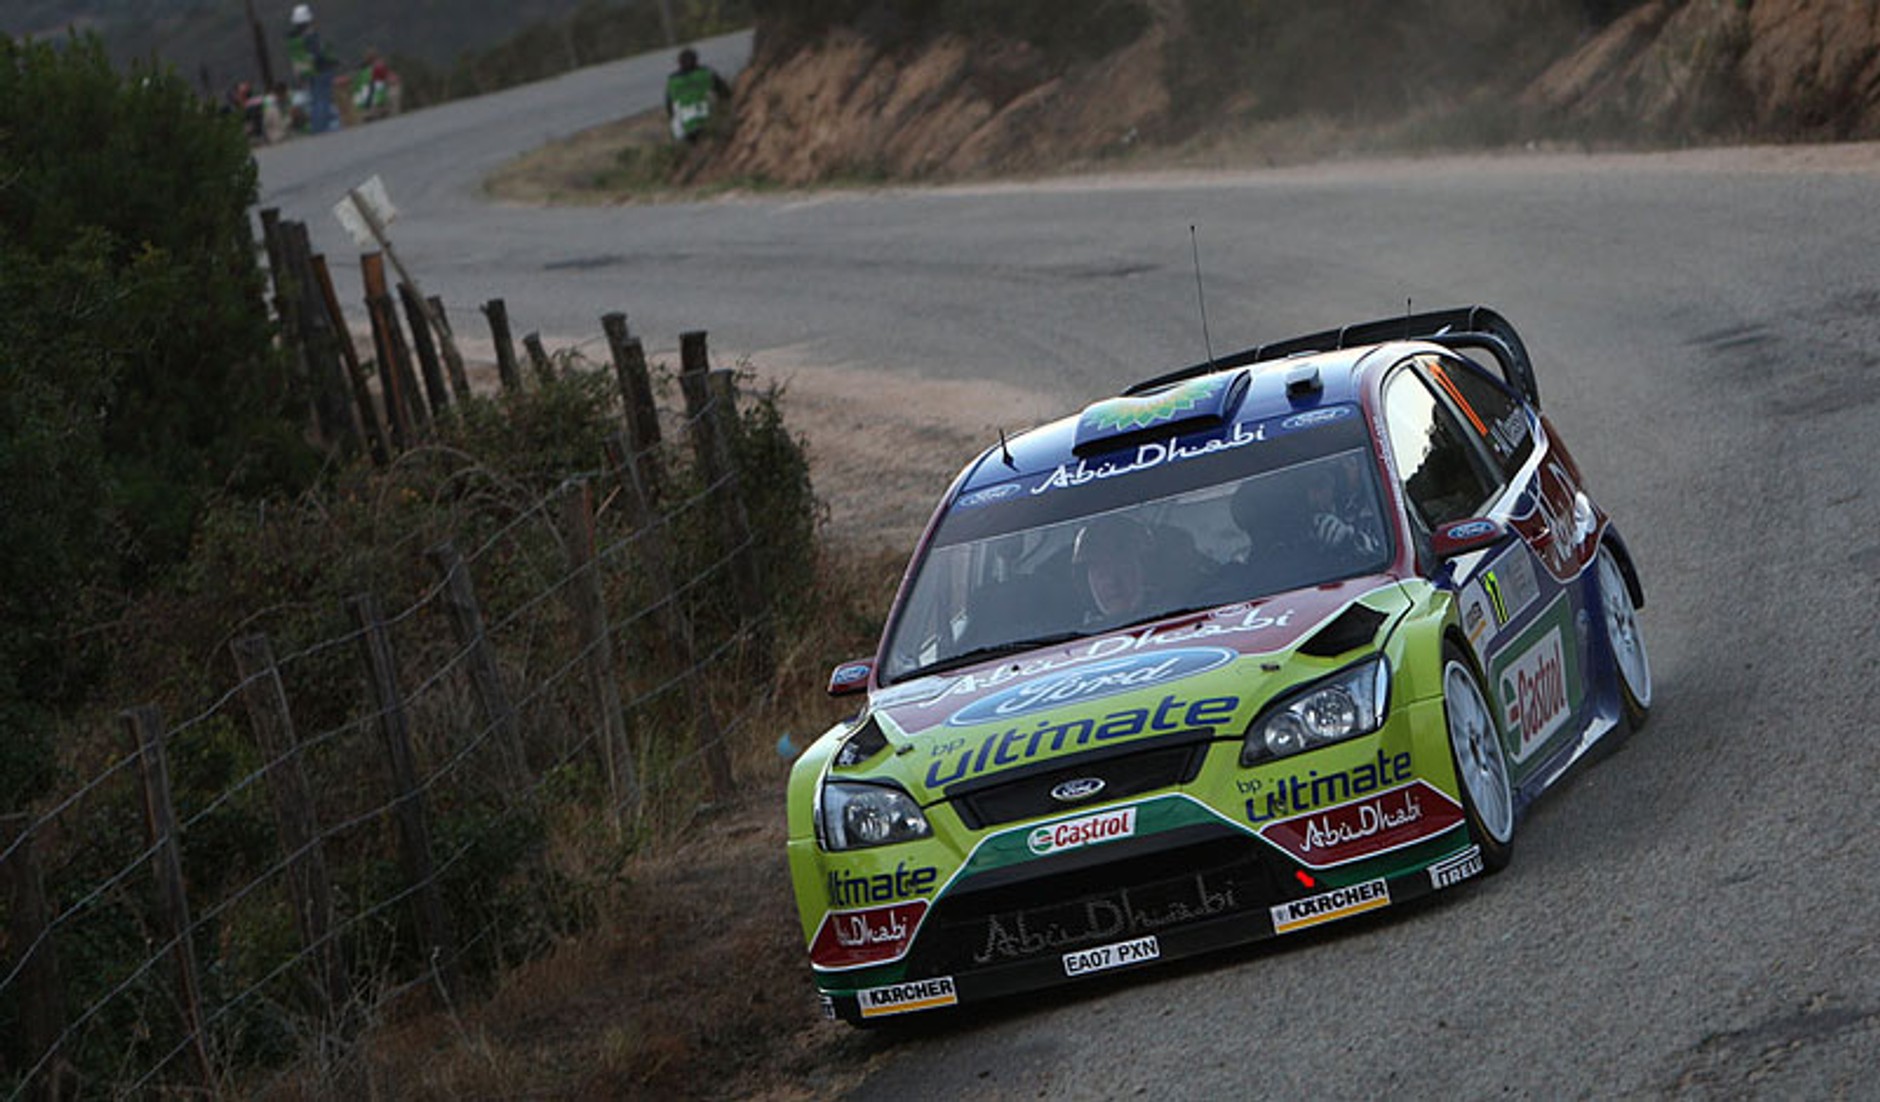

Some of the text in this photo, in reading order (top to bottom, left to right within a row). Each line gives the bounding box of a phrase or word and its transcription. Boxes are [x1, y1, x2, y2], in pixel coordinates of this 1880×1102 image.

[997, 656, 1180, 714] Ford
[924, 695, 1241, 789] ultimate
[930, 736, 966, 760] bp
[1056, 780, 1101, 799] Ford
[1236, 777, 1263, 796] bp
[1245, 748, 1412, 823] ultimate
[1054, 811, 1130, 848] Castrol
[1065, 939, 1159, 974] EA07 PXN
